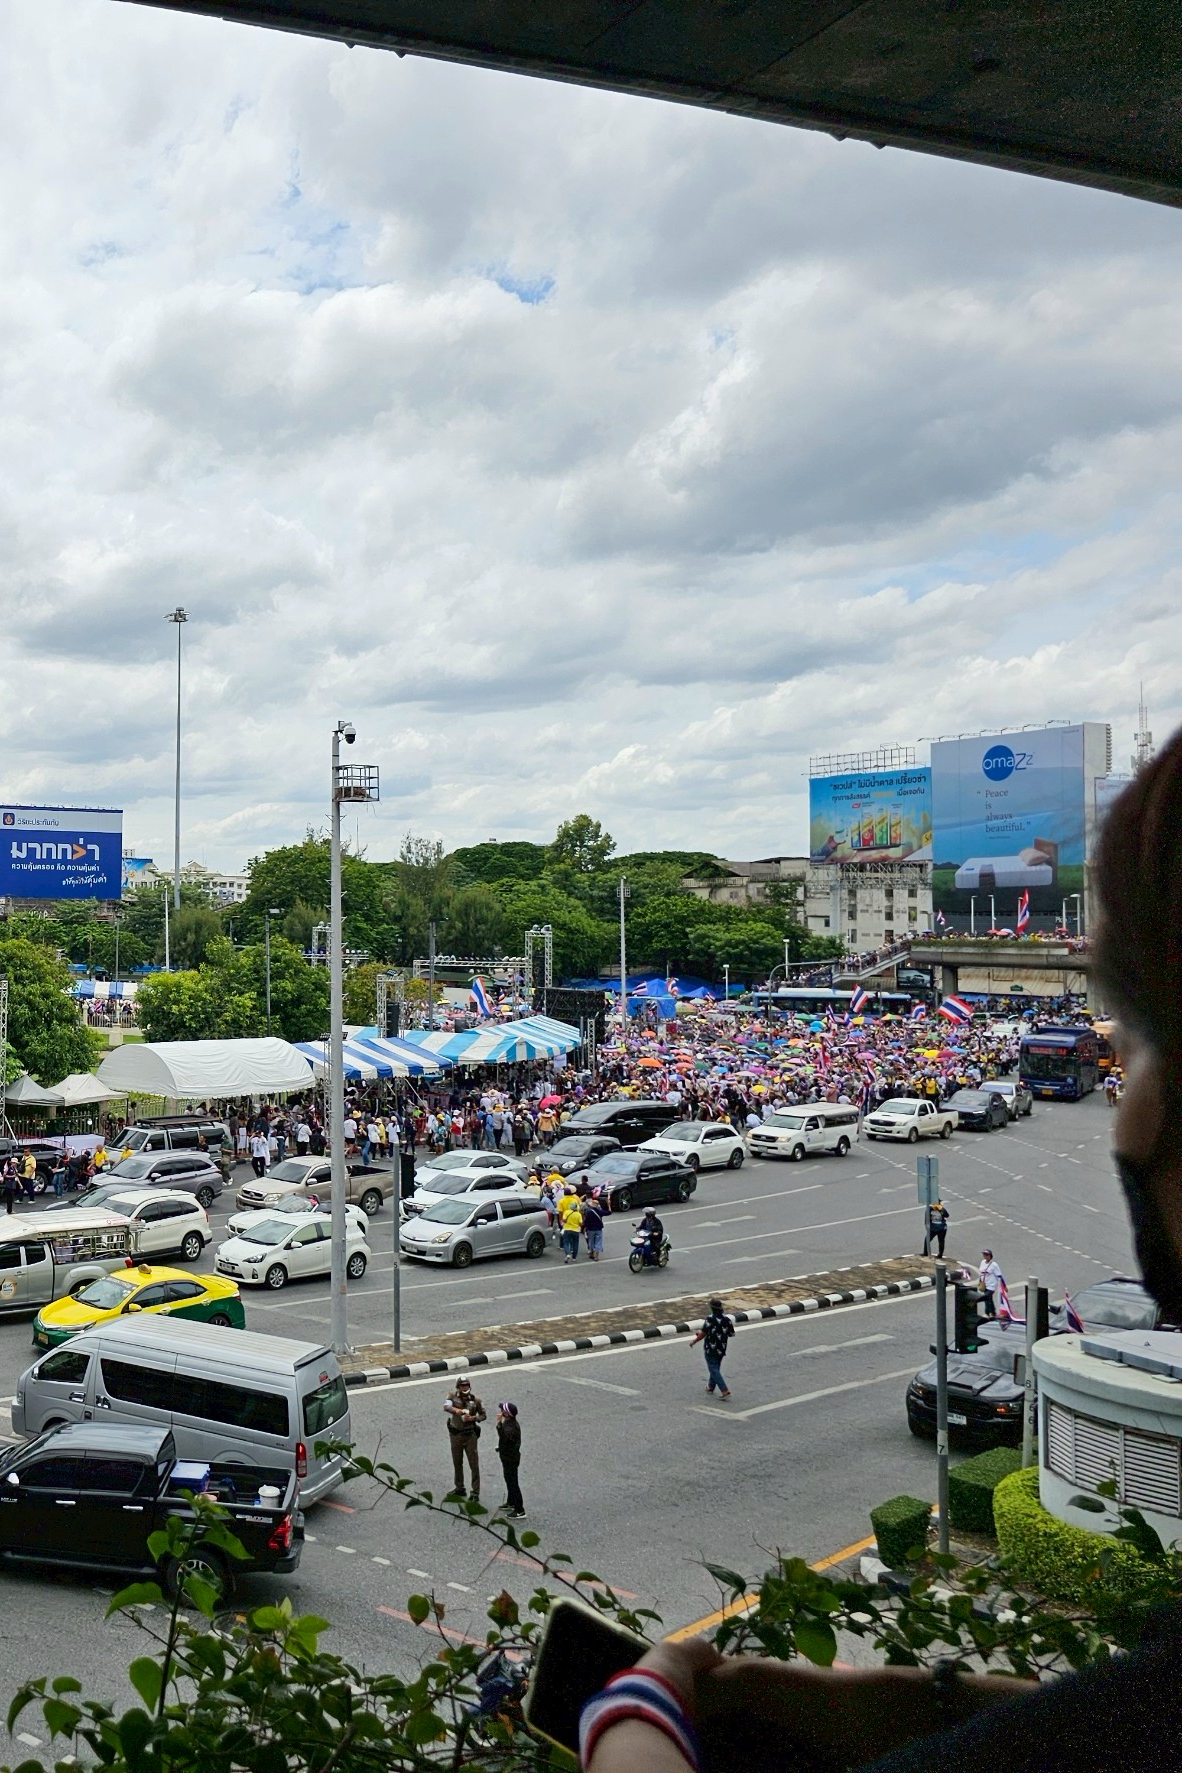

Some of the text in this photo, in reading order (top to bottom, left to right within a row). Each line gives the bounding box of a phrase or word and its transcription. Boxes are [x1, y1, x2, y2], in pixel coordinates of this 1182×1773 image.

[985, 790, 1009, 798] Peace
[985, 812, 1013, 823] always
[393, 1261, 398, 1269] 5
[1025, 1379, 1032, 1389] 6
[938, 1444, 945, 1454] 7
